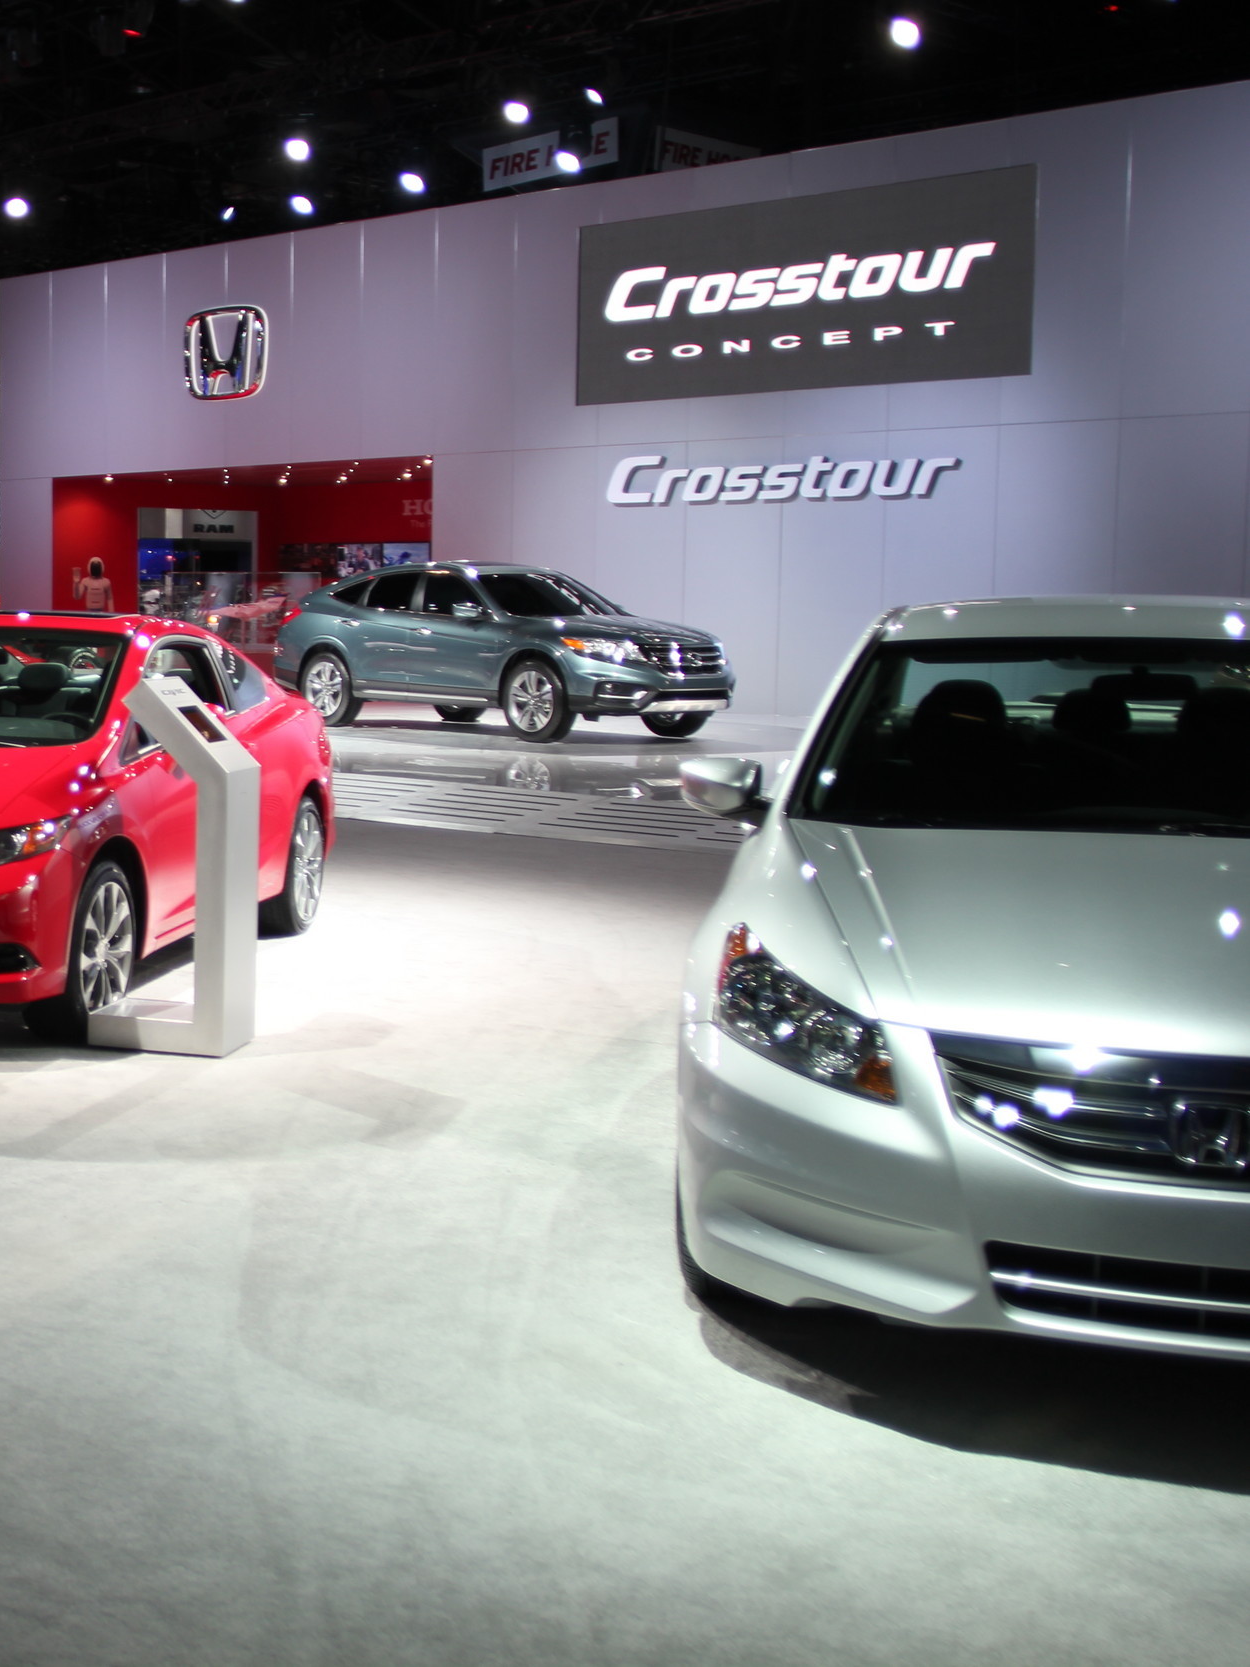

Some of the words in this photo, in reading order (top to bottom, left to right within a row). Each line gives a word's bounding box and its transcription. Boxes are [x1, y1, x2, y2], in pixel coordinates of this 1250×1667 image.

[489, 148, 540, 180] FIRE
[659, 140, 703, 167] FIRE
[604, 241, 996, 322] Crosstour
[626, 320, 956, 362] CONCEPT
[607, 455, 960, 506] Crosstour
[193, 523, 234, 533] RAM
